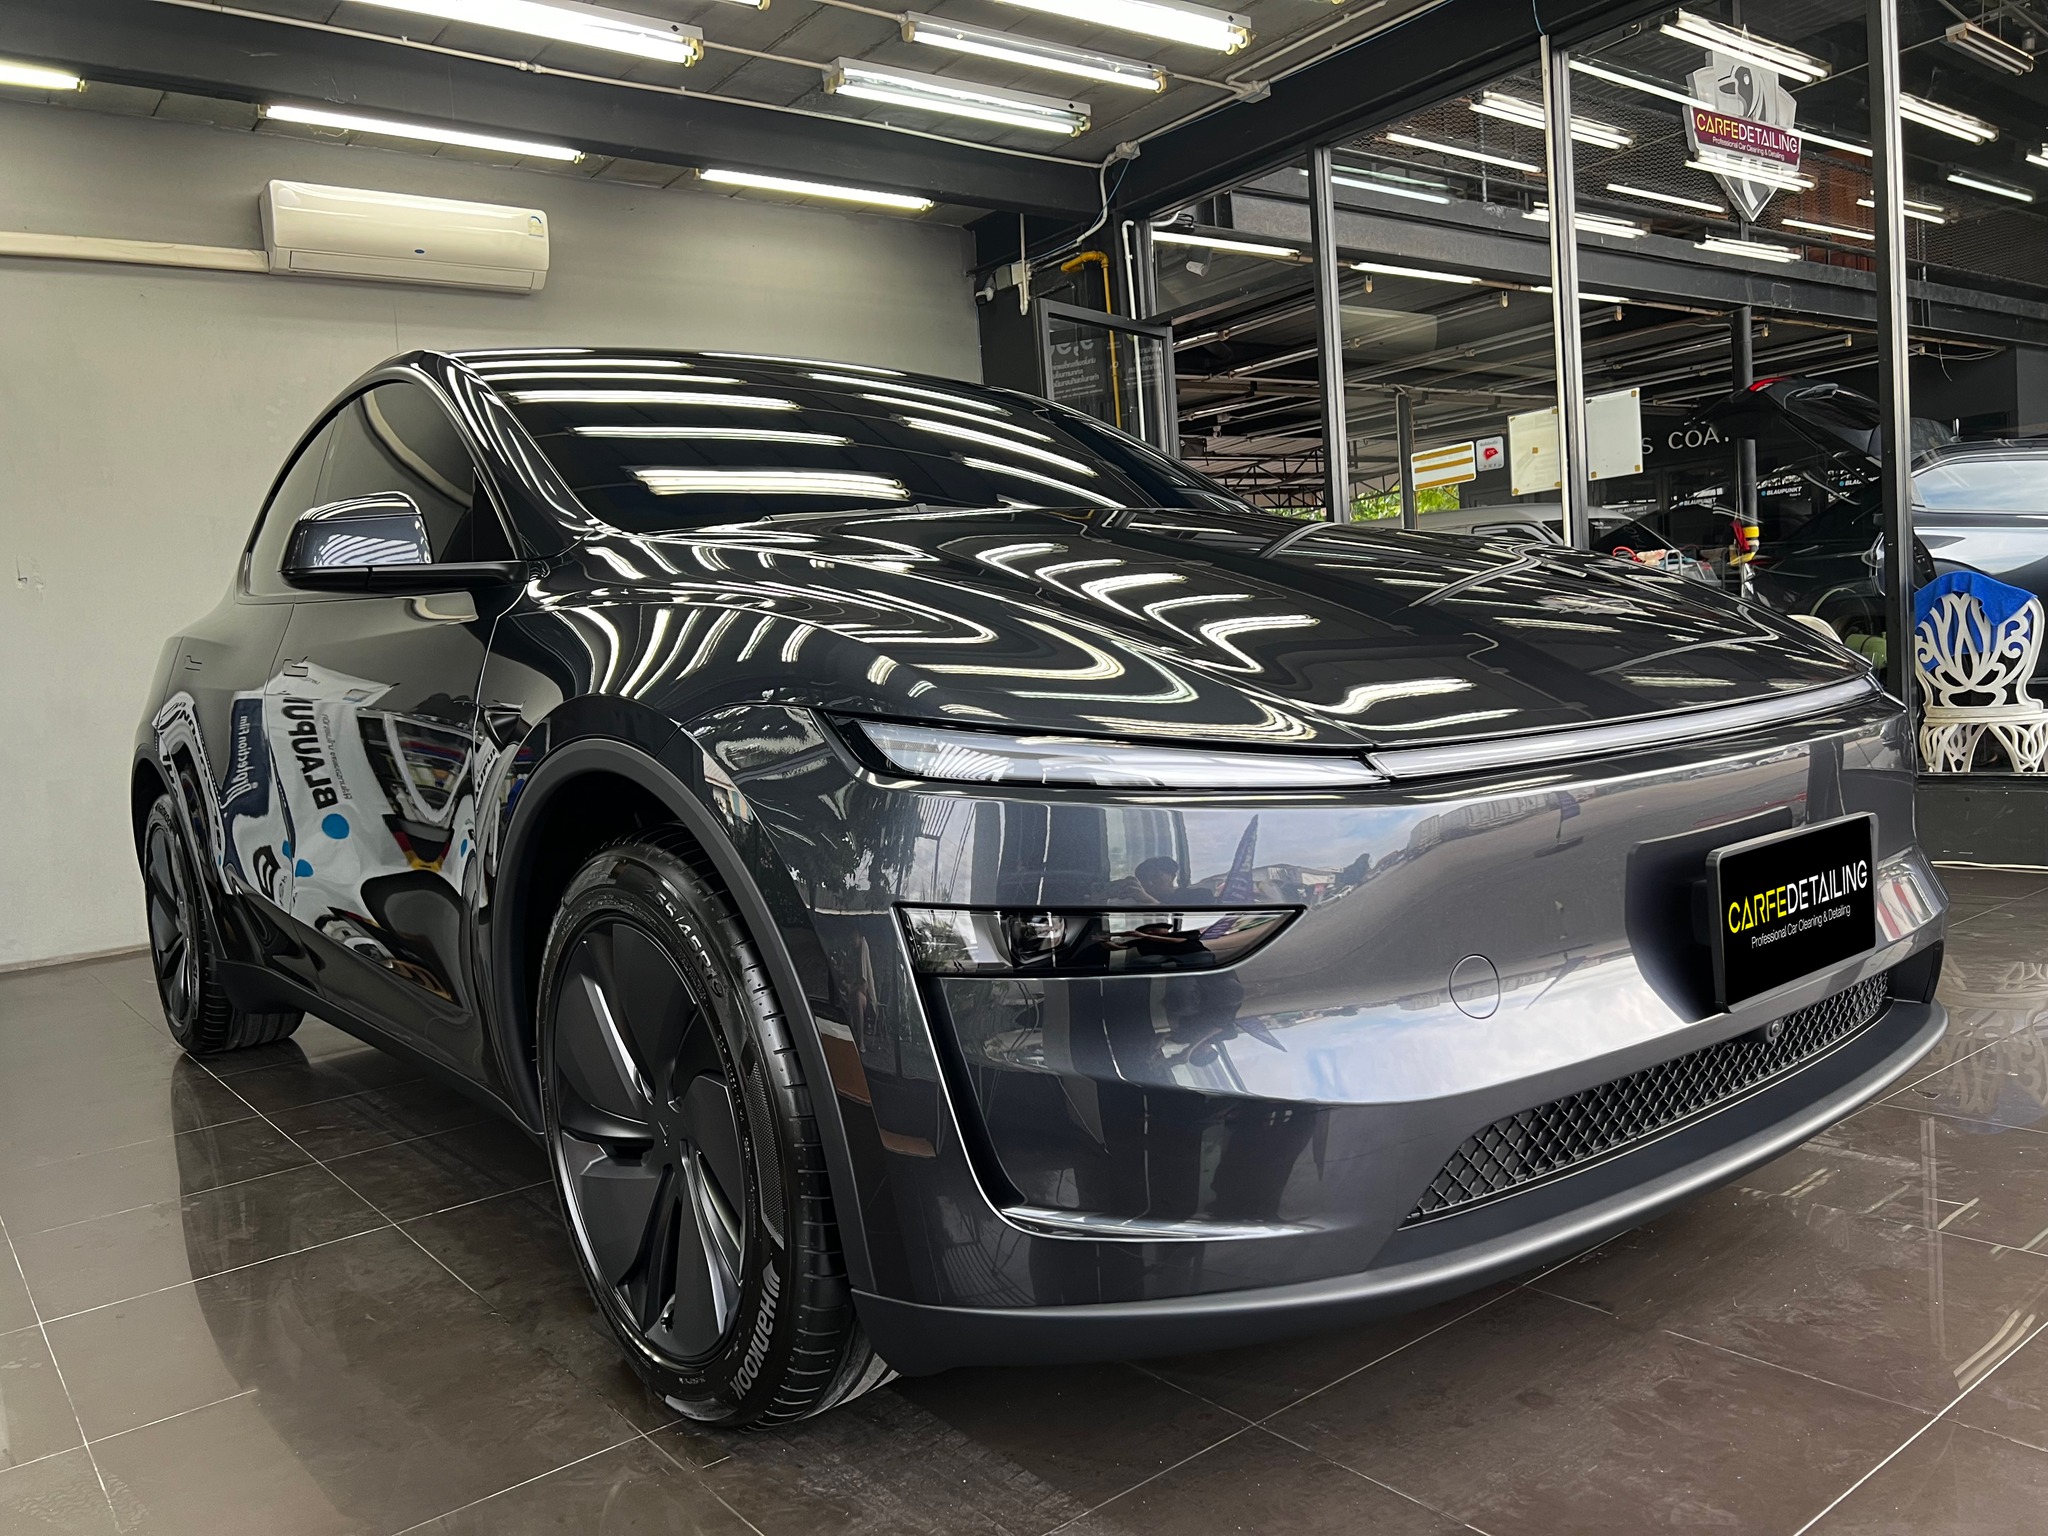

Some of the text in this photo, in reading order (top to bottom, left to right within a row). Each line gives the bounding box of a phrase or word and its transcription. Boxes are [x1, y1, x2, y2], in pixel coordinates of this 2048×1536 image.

[1697, 114, 1797, 154] CARFEDETAILING
[1713, 136, 1738, 149] Professional
[1739, 141, 1747, 151] Car
[1747, 144, 1764, 156] Cleaning
[1768, 149, 1785, 161] Detailing
[1766, 486, 1802, 496] BLAUPUNKT
[1728, 860, 1867, 933] CARFEDETAILING
[1751, 904, 1851, 949] Professional Car Cleaning & Detailing
[729, 1288, 777, 1400] Hankook
